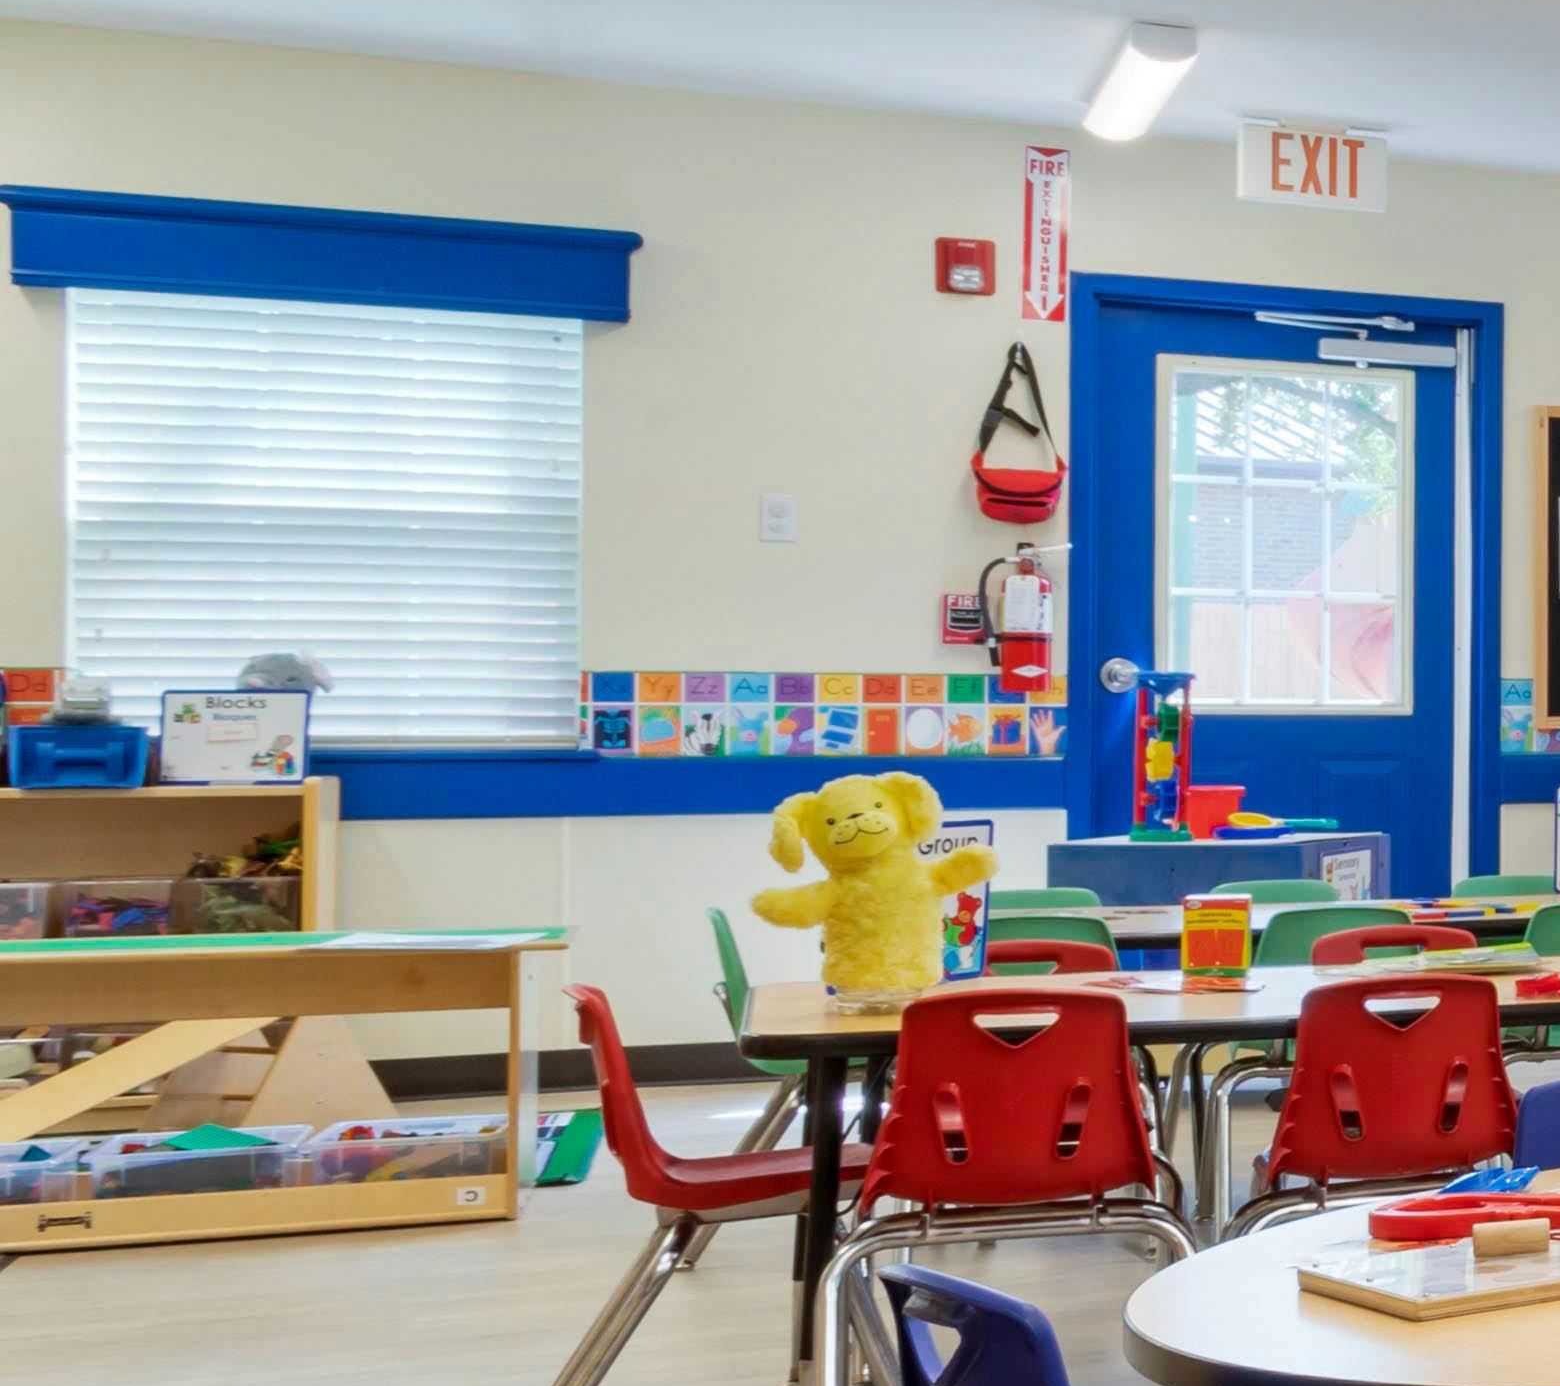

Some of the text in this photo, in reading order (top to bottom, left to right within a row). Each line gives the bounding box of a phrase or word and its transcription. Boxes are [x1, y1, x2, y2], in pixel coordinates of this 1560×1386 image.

[1030, 158, 1064, 177] FIRE
[1271, 131, 1366, 198] EXIT
[205, 696, 267, 710] Blocks
